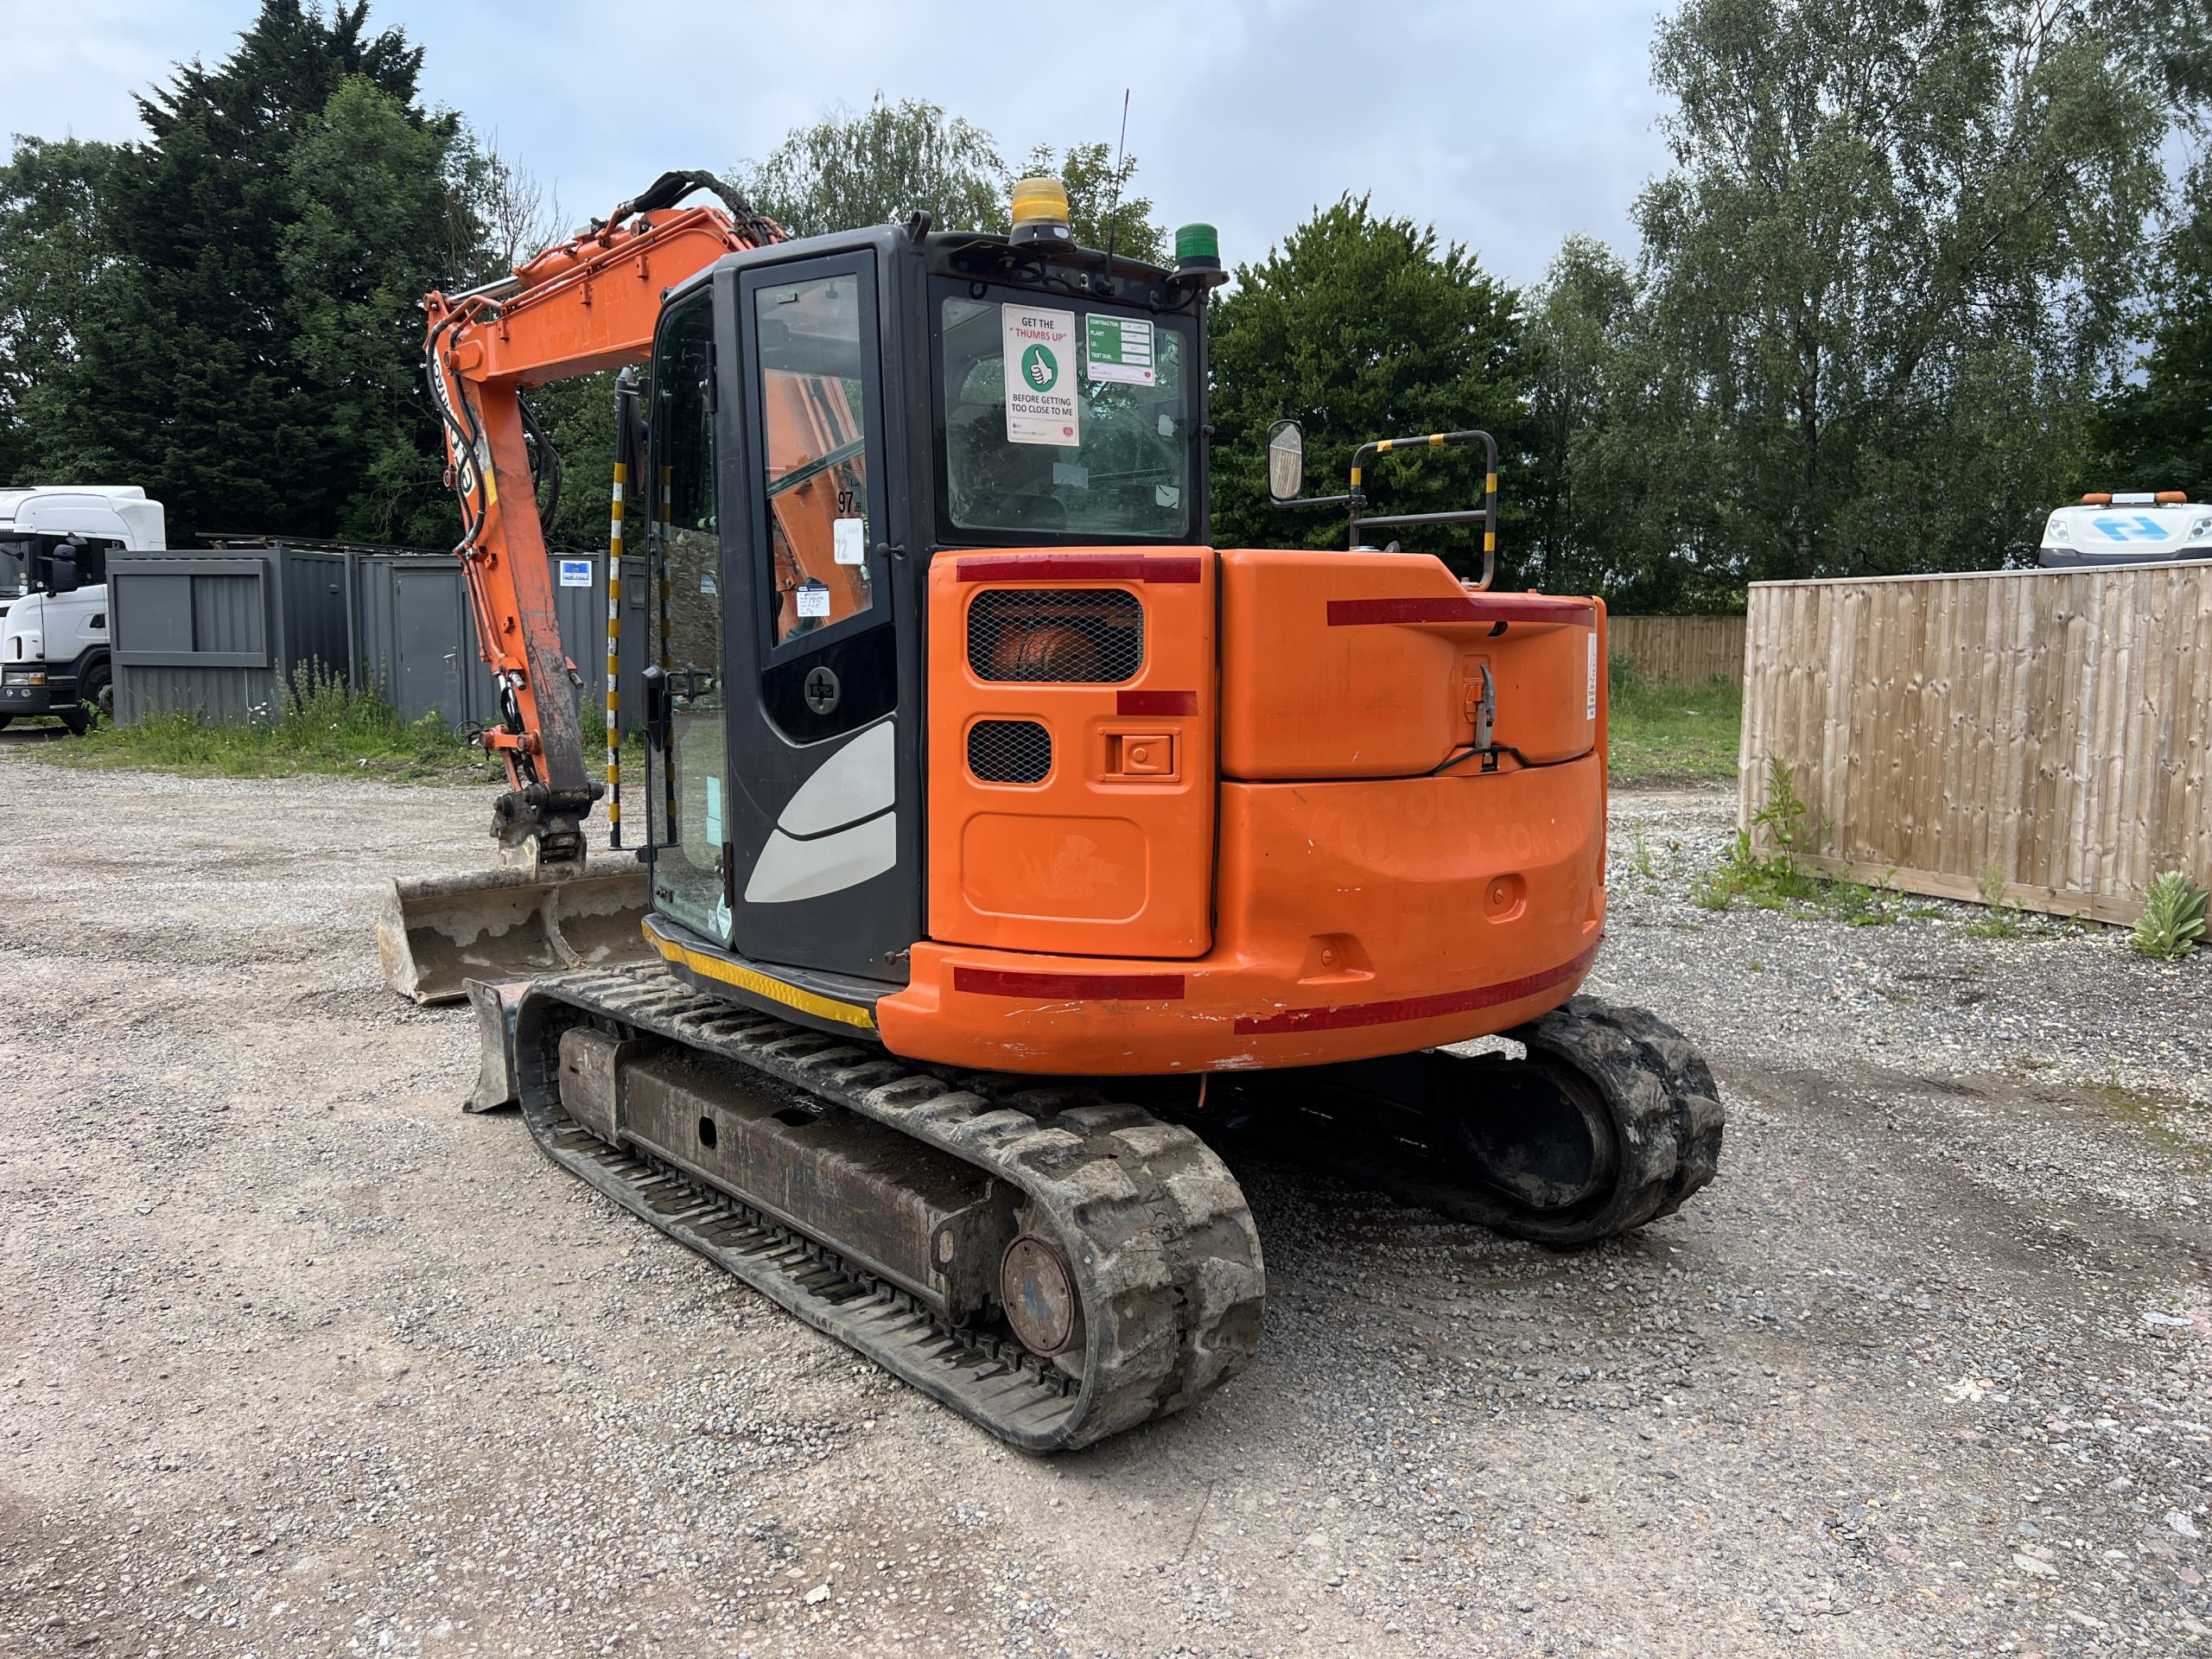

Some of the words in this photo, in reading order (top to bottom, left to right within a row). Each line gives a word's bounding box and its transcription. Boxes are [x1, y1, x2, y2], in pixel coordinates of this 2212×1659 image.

[1021, 316, 1037, 327] GET
[1039, 319, 1054, 329] THE
[1090, 319, 1120, 327] CONTRACTOR:
[1052, 333, 1067, 342] UP"
[1013, 394, 1039, 404] BEFORE
[1041, 397, 1071, 406] GETTING
[1012, 404, 1027, 412] TOO
[1028, 405, 1050, 414] CLOSE
[838, 491, 854, 513] 97
[836, 537, 848, 559] 72
